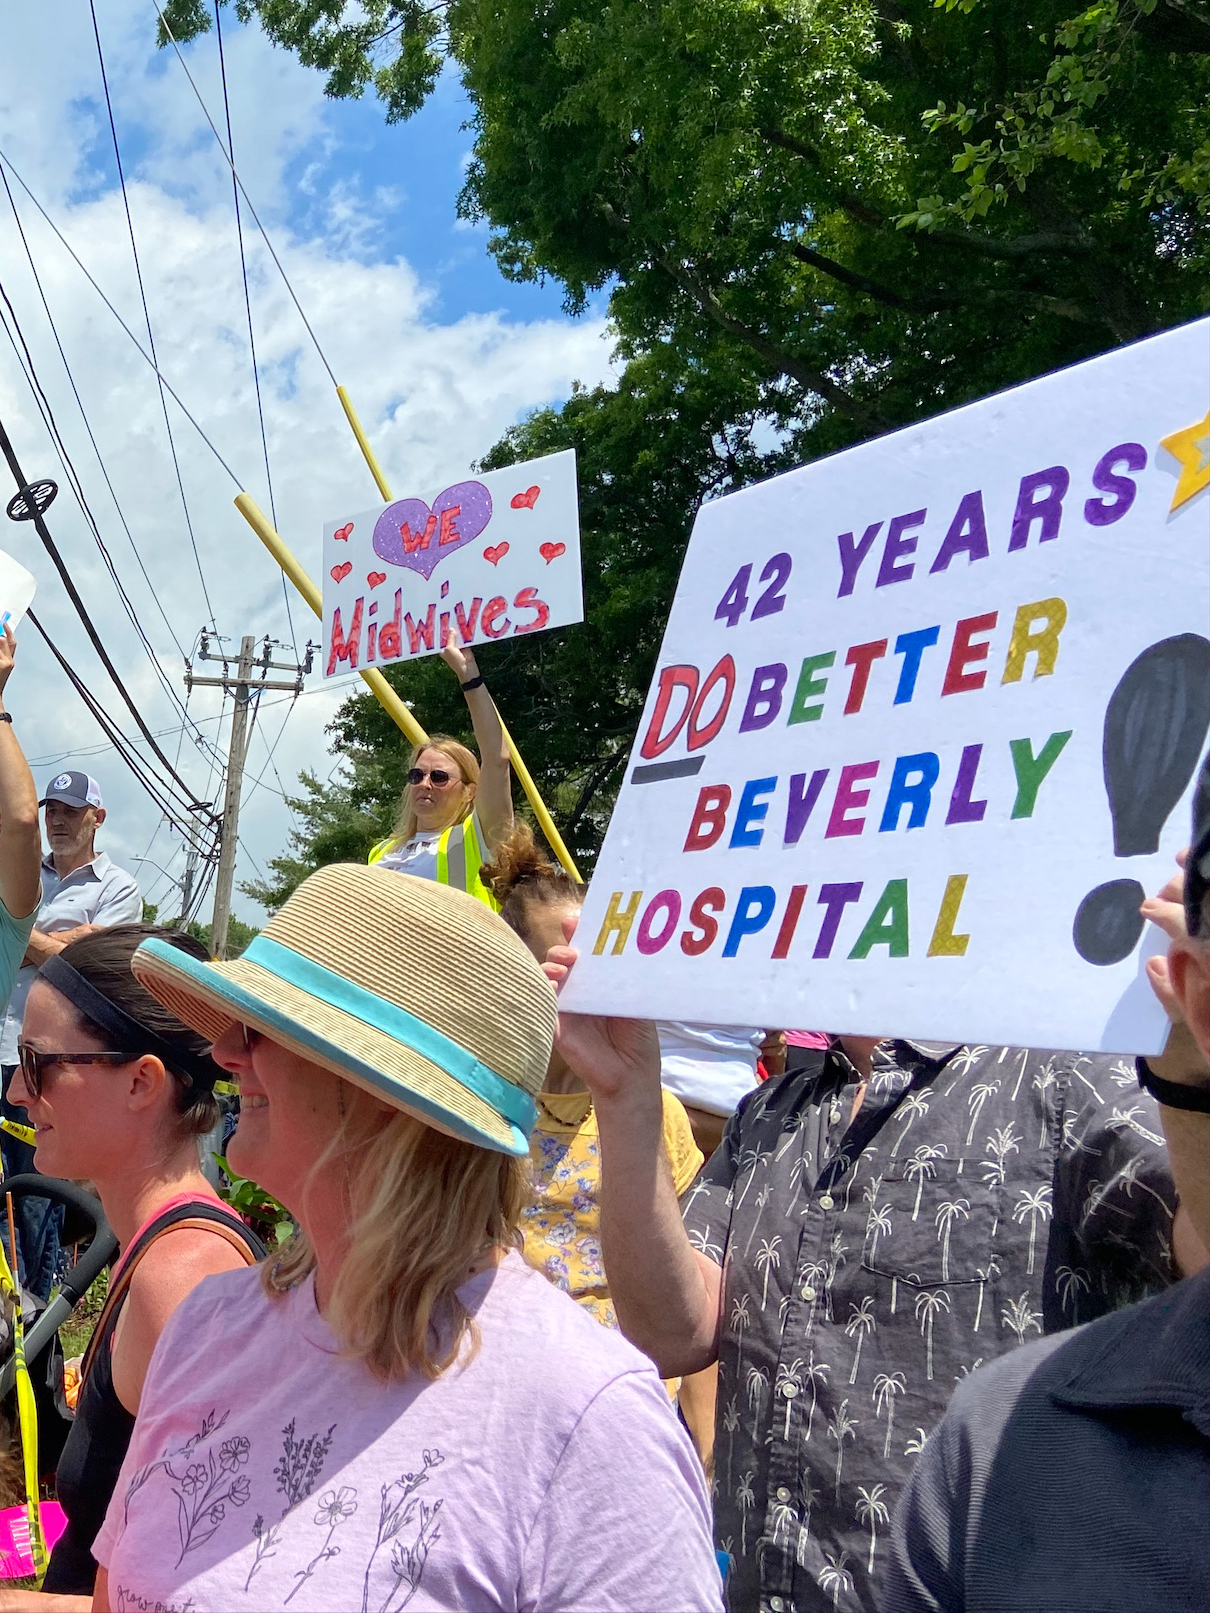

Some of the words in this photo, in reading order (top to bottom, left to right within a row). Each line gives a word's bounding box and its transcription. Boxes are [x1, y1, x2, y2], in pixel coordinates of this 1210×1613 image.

[399, 504, 462, 554] WE
[714, 551, 793, 628] 42
[835, 441, 1149, 599] YEARS
[326, 580, 551, 677] Midwives
[639, 652, 737, 762] DO
[738, 596, 1069, 735] BETTER
[682, 729, 1075, 854] BEVERLY
[591, 873, 971, 961] HOSPITAL
